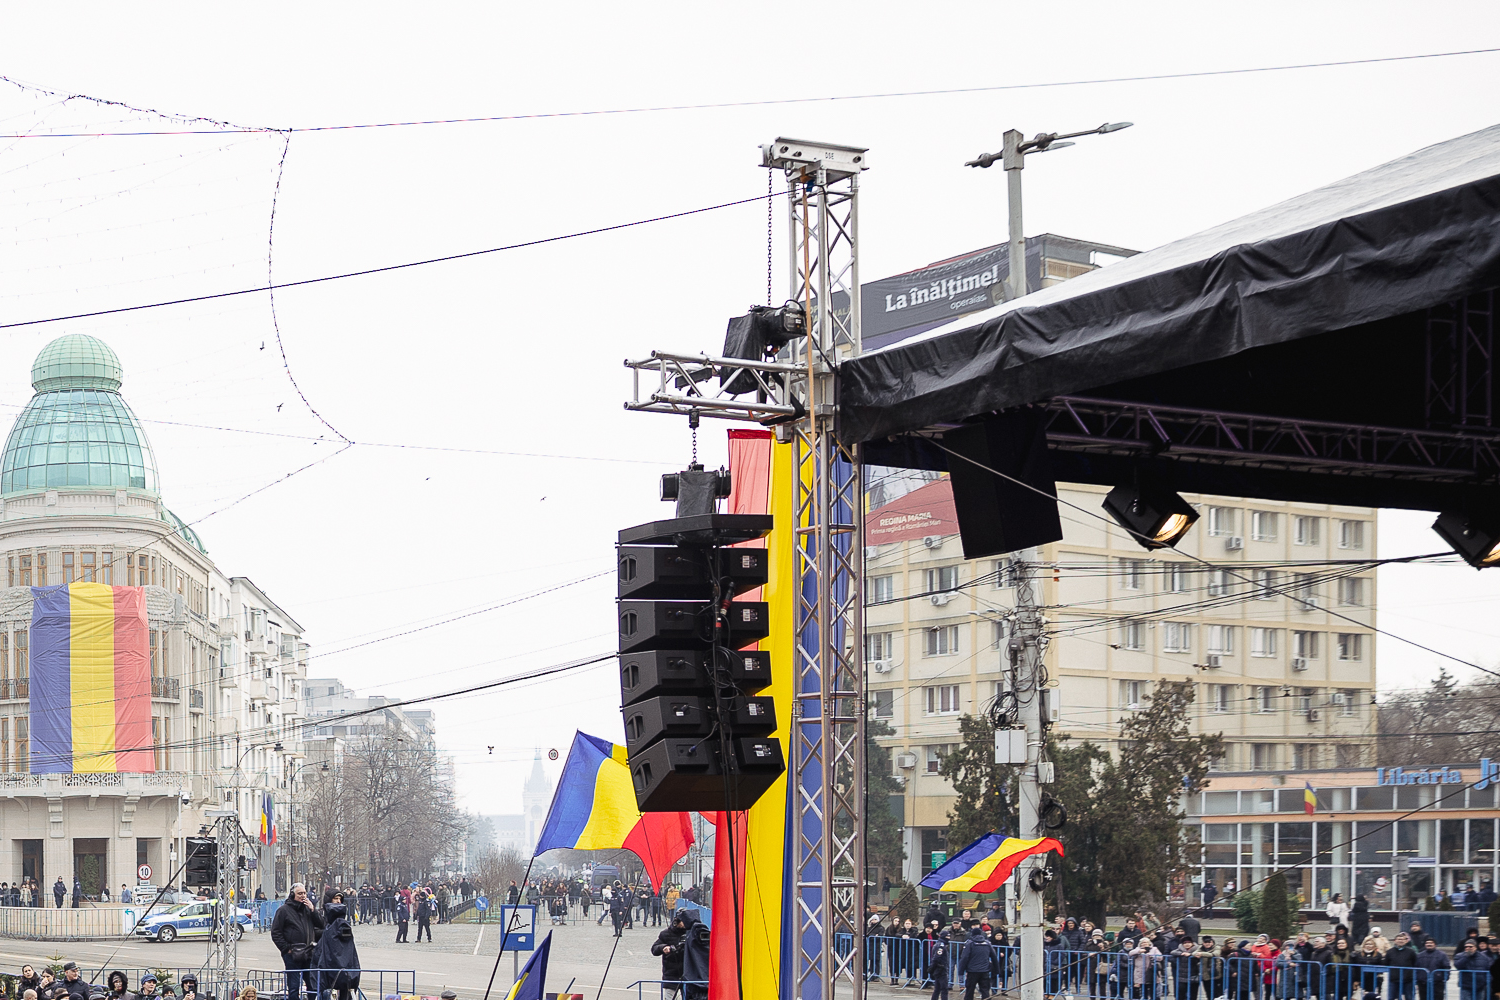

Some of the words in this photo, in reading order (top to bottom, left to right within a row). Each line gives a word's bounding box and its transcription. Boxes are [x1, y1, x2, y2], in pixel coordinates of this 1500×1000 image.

[885, 291, 907, 313] La
[909, 264, 999, 306] înălțime!
[949, 293, 988, 312] operaias
[880, 516, 907, 526] REGINA
[908, 512, 932, 522] MARIA
[141, 867, 149, 877] 10
